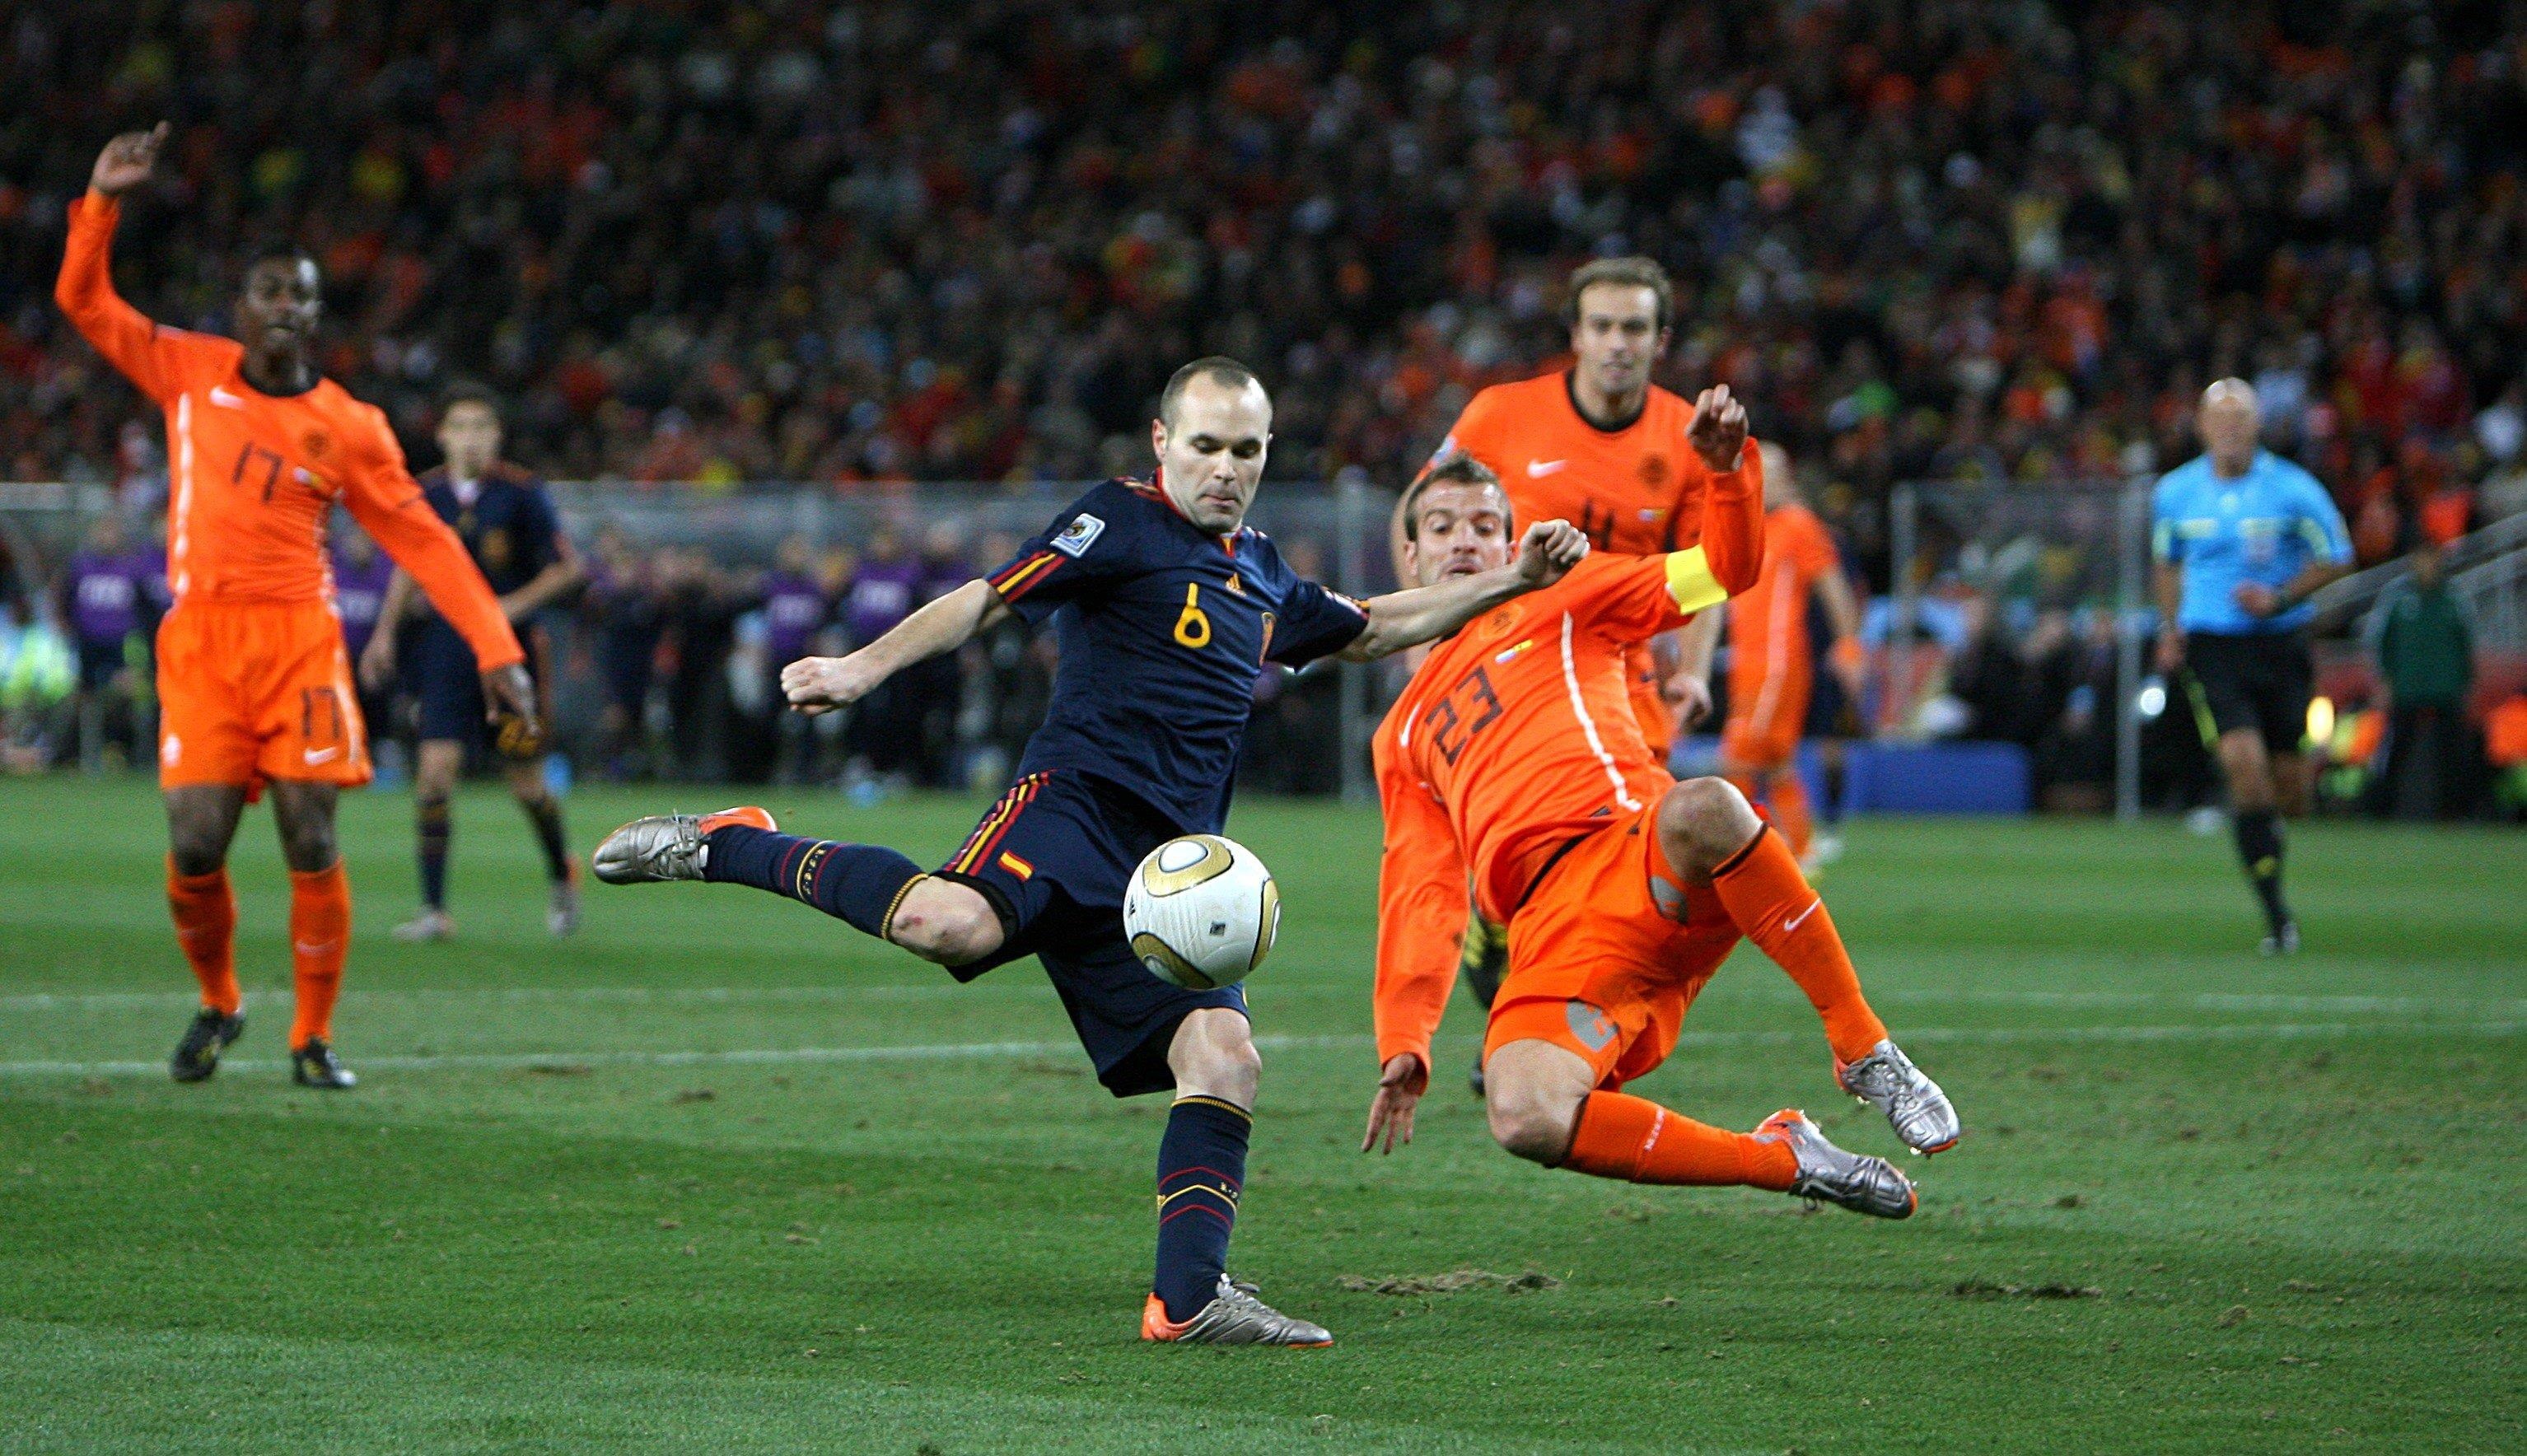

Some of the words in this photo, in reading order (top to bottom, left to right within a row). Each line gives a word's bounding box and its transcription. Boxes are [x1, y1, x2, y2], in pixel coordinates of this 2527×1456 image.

[232, 441, 283, 505] 17
[1174, 582, 1212, 649] 6
[300, 685, 342, 740] 17
[1425, 665, 1504, 768] 23
